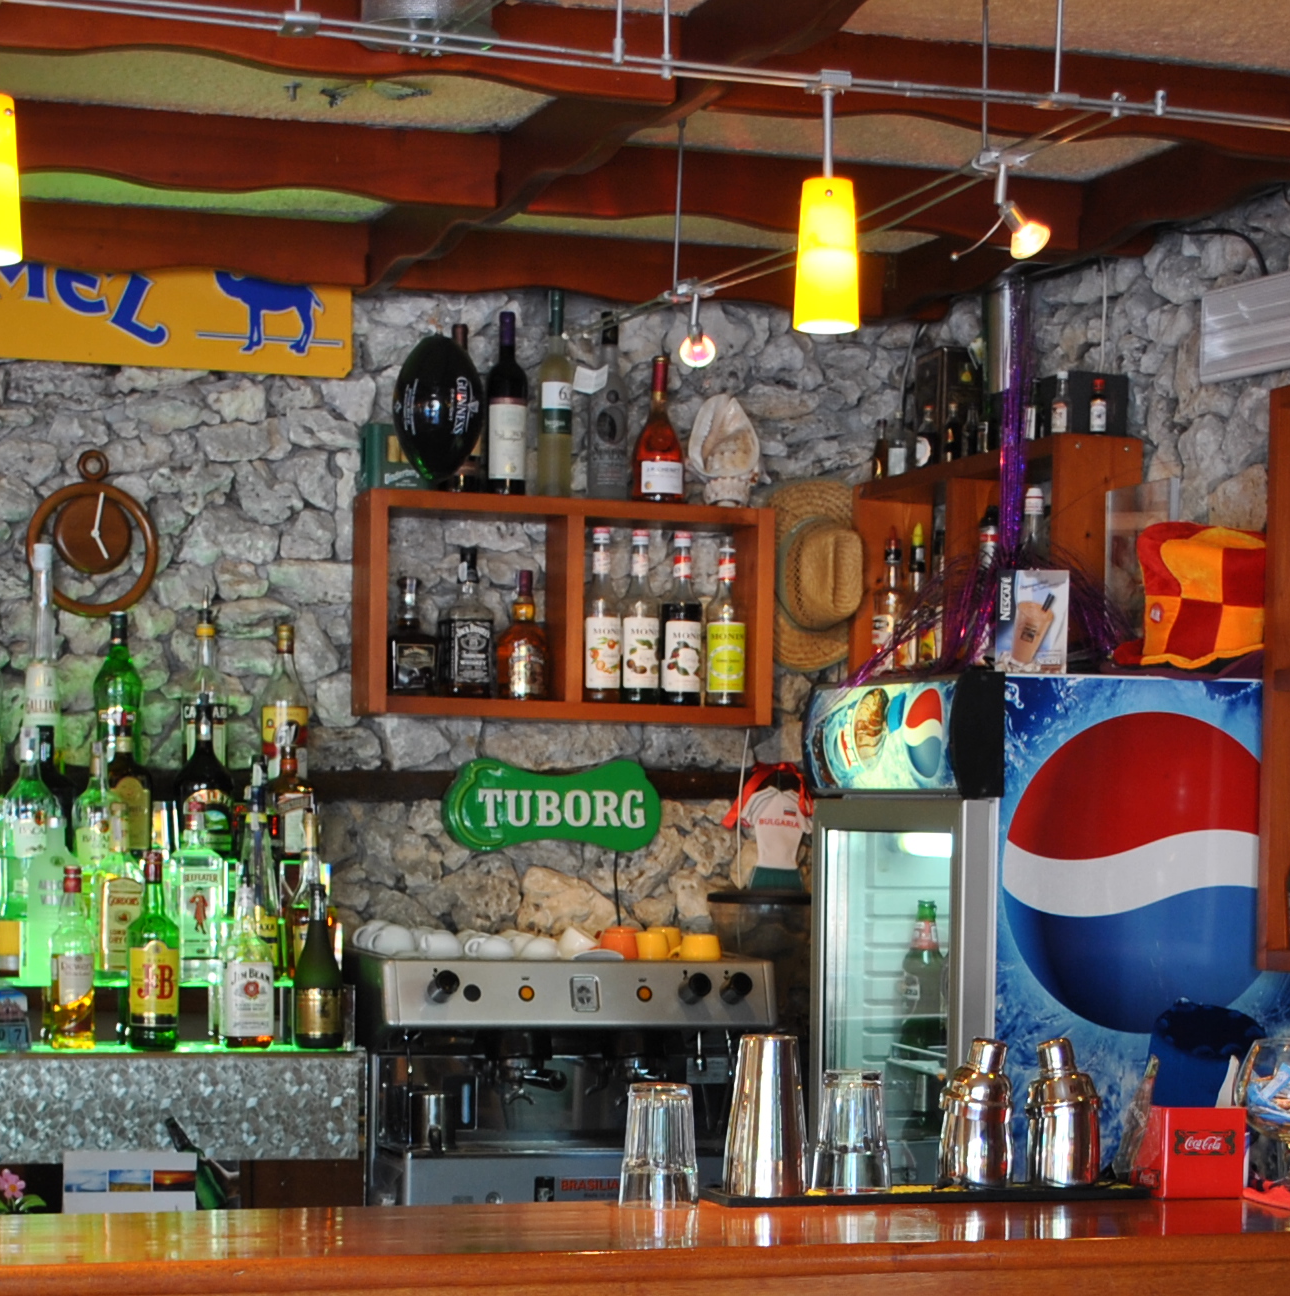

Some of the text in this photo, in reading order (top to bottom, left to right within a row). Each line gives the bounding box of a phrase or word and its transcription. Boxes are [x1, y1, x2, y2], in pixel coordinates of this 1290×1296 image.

[452, 376, 468, 435] GUINNESS
[478, 788, 647, 829] TUBORG
[758, 817, 801, 829] BULGARIA
[248, 967, 272, 983] BEAM
[561, 1179, 620, 1191] BRASILIA
